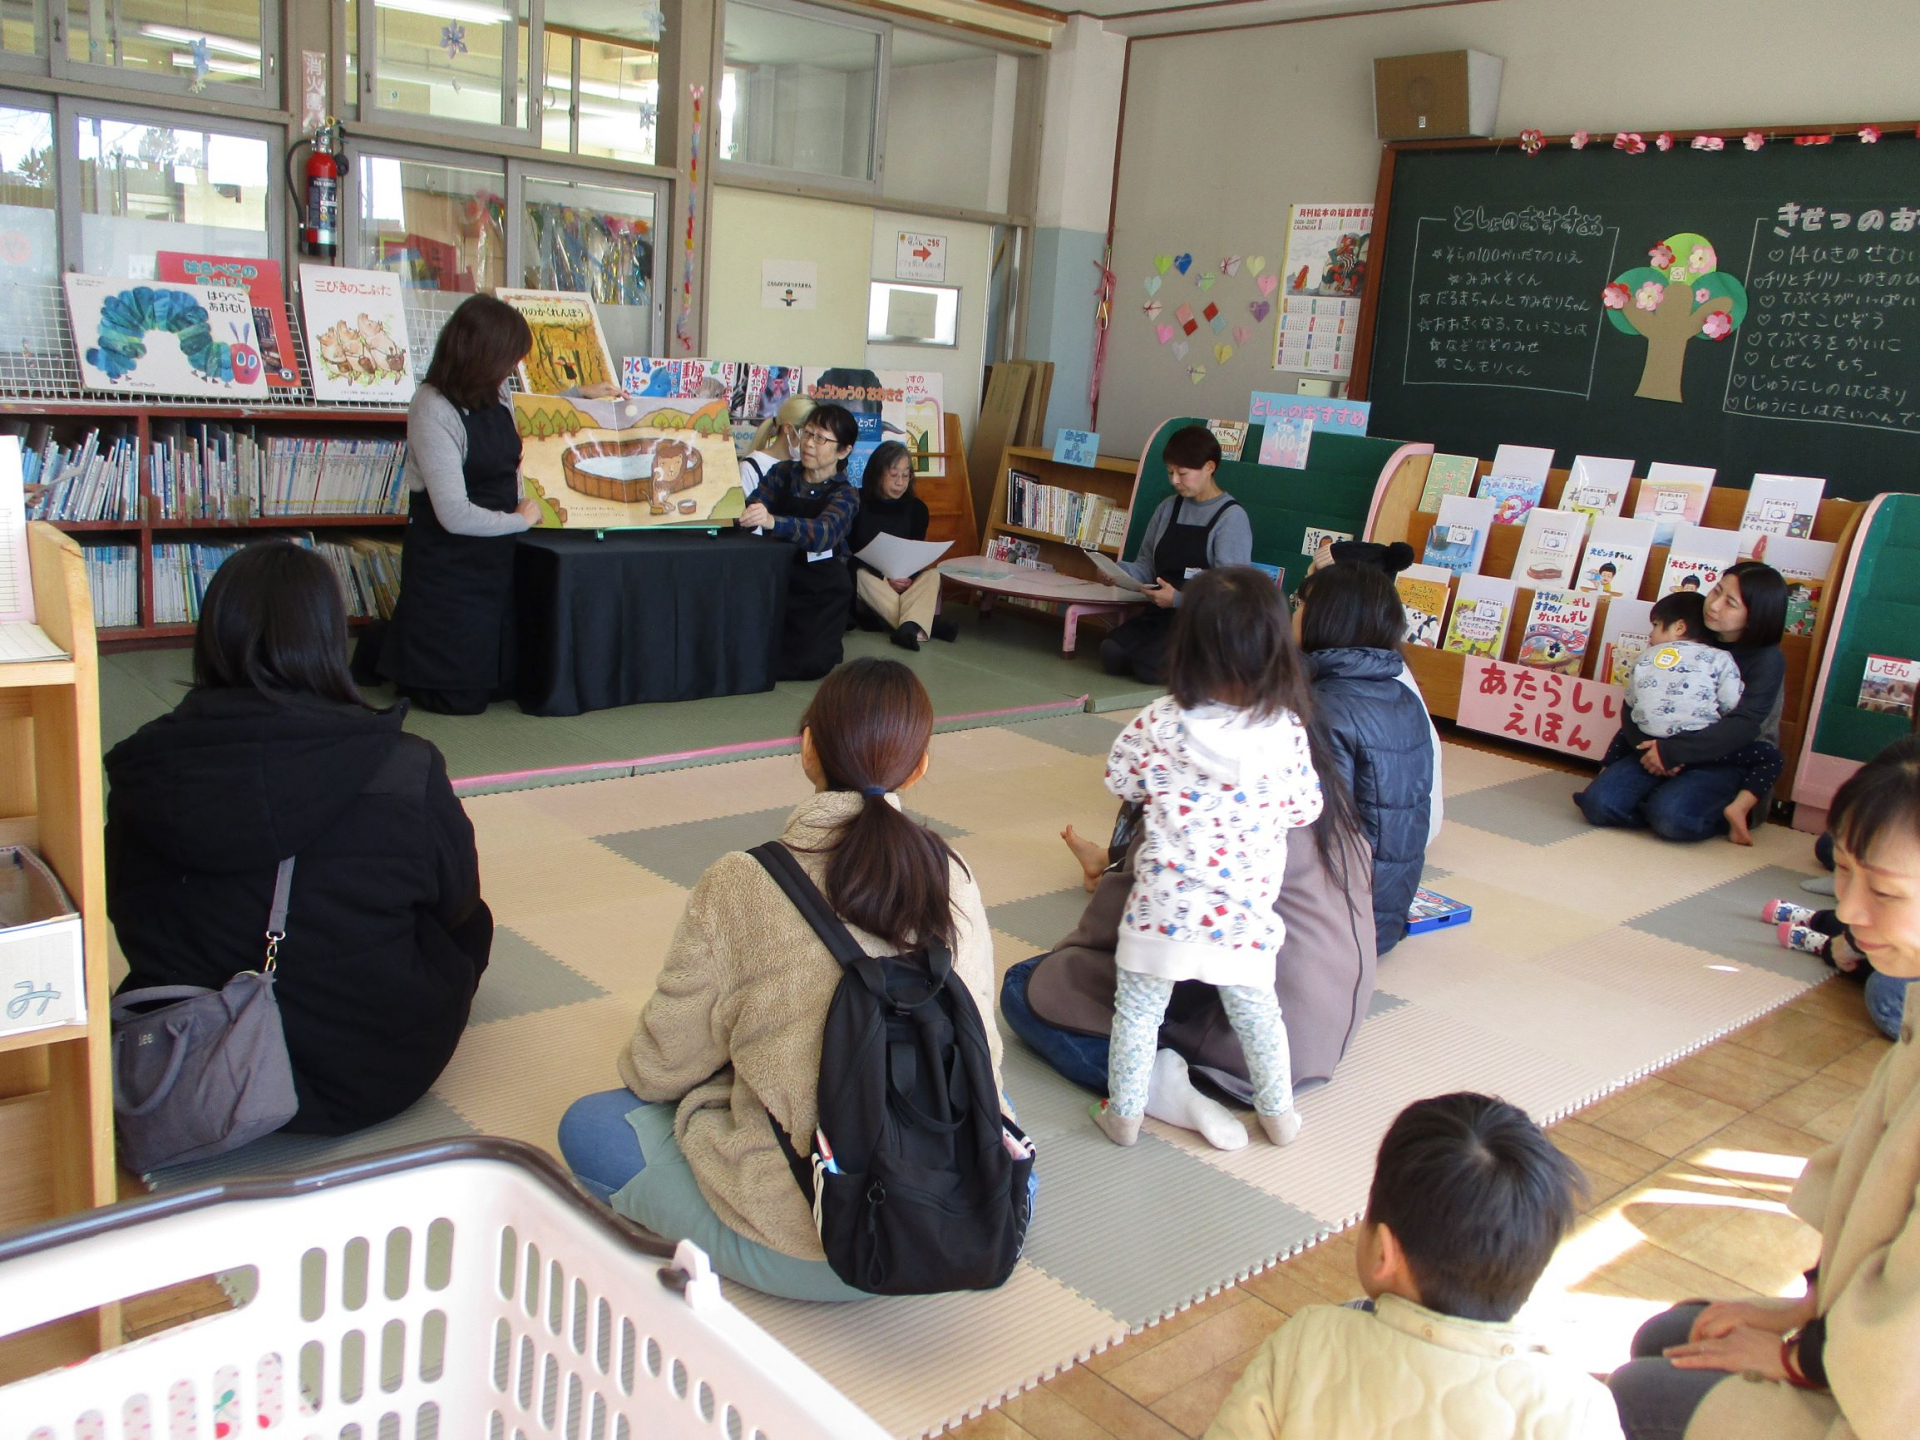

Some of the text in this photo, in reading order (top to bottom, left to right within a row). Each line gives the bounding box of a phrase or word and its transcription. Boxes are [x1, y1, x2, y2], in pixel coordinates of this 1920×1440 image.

[1773, 202, 1920, 238] きせつのお
[207, 290, 246, 303] はらぺこ
[315, 280, 392, 296] 三びきのこぶた
[208, 302, 247, 314] あおむし
[1251, 397, 1367, 428] としょのおすすめ
[1744, 395, 1920, 425] じゅうにしはたいへんで
[1869, 660, 1910, 678] しぜん
[1504, 703, 1591, 751] えほん
[6, 980, 61, 1020] み
